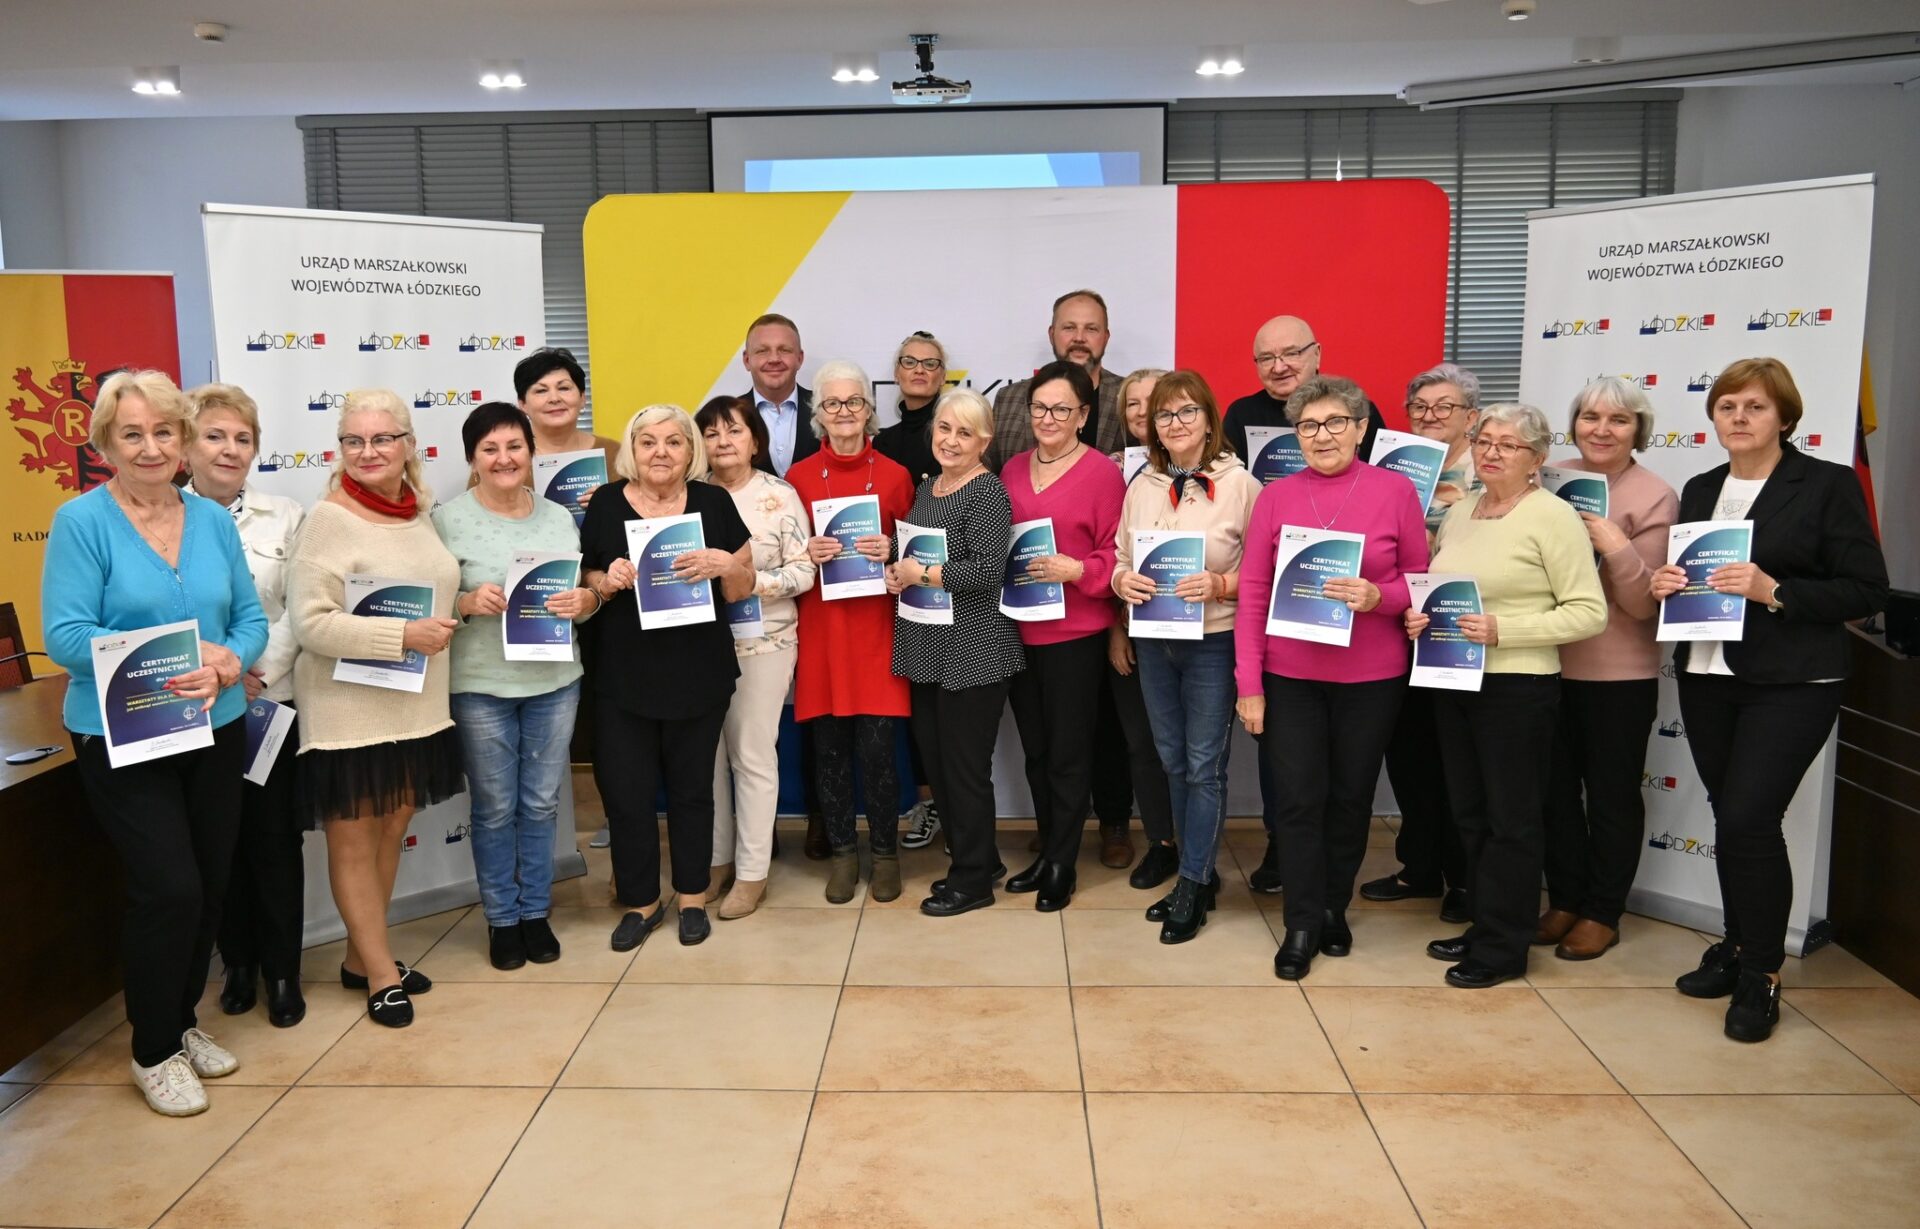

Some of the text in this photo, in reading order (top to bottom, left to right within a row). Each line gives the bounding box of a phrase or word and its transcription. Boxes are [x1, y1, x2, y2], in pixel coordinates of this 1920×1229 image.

[1598, 231, 1770, 258] URZĄD MARSZAŁKOWSKI
[300, 256, 467, 274] URZĄD MARSZAŁKOWSKI
[1587, 255, 1784, 282] WOJEWÓDZTWA ŁÓDZKIEGO
[291, 278, 481, 296] WOJEWÓDZTWA ŁÓDZKIEGO
[1543, 319, 1605, 338] ŁÓDZKIE
[1640, 315, 1711, 335] ŁÓDZKIE
[1747, 310, 1827, 332] ŁÓDZKIE
[247, 331, 323, 351] ŁÓDZKIE
[359, 332, 427, 351] ŁÓDZKIE
[459, 333, 523, 352] ŁÓDZKIE
[414, 389, 479, 408] ŁÓDZKIE
[61, 408, 88, 437] R
[370, 604, 424, 617] UCZESTNICTWA
[383, 599, 425, 610] CERTYFIKAT
[126, 661, 192, 679] UCZESTNICTWA
[141, 653, 191, 668] CERTYFIKAT
